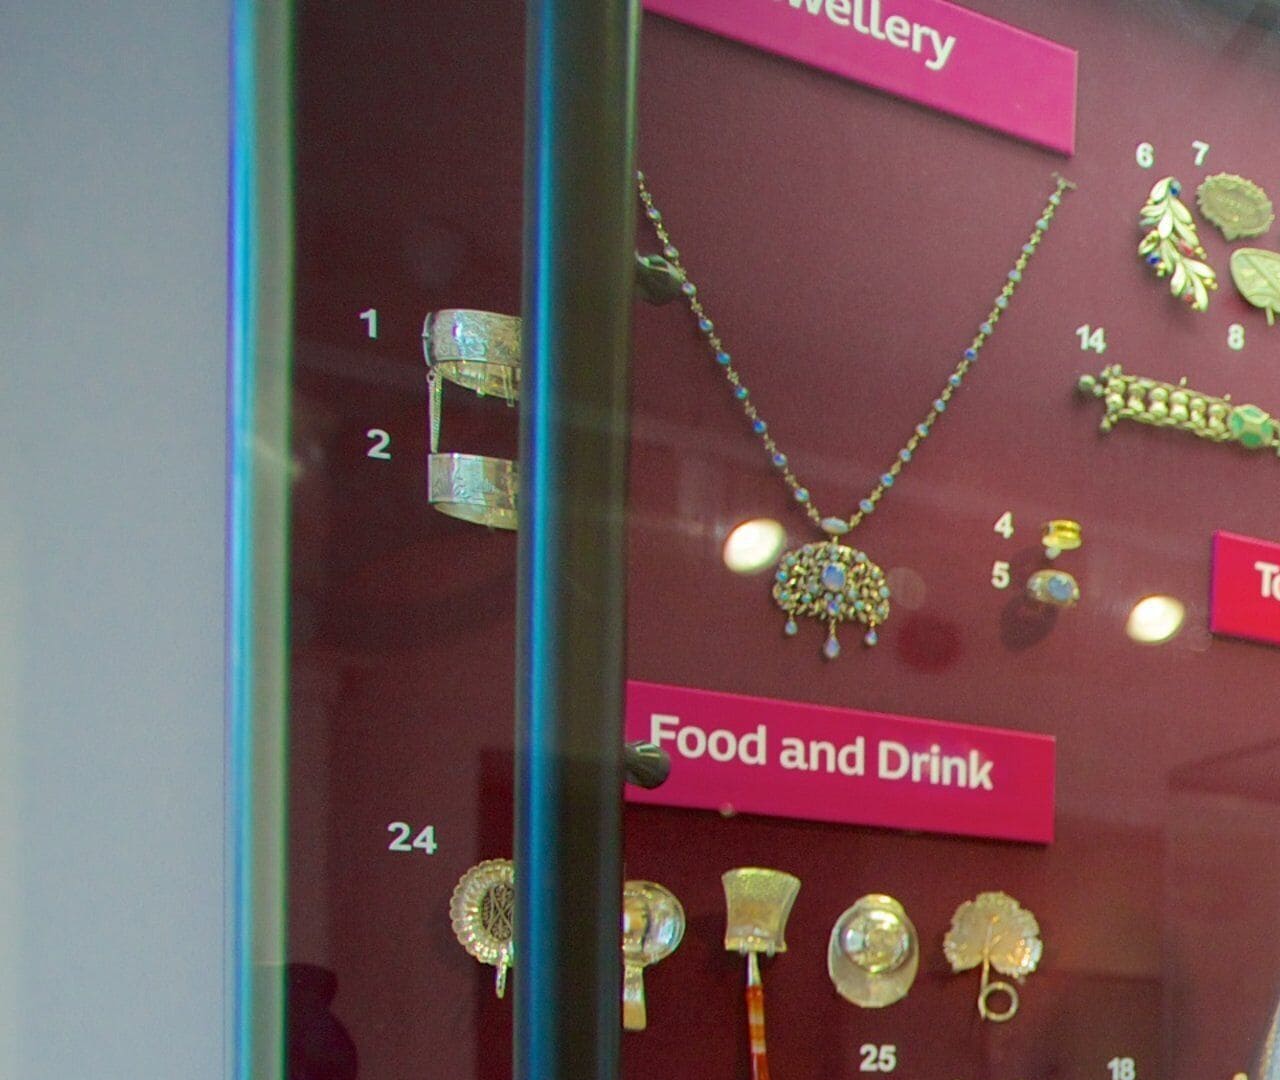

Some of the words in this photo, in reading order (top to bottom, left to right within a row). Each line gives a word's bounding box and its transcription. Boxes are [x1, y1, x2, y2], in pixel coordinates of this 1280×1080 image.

[773, 0, 956, 70] wellery
[1135, 142, 1154, 169] 6
[1192, 140, 1210, 166] 7
[359, 308, 377, 339] 1
[1227, 324, 1245, 351] 8
[1076, 324, 1107, 354] 14
[367, 428, 392, 460] 2
[994, 511, 1014, 539] 4
[991, 560, 1010, 589] 5
[649, 713, 768, 766] Food
[779, 736, 866, 777] and
[877, 740, 995, 791] Drink
[387, 821, 438, 855] 24
[859, 1043, 897, 1072] 25
